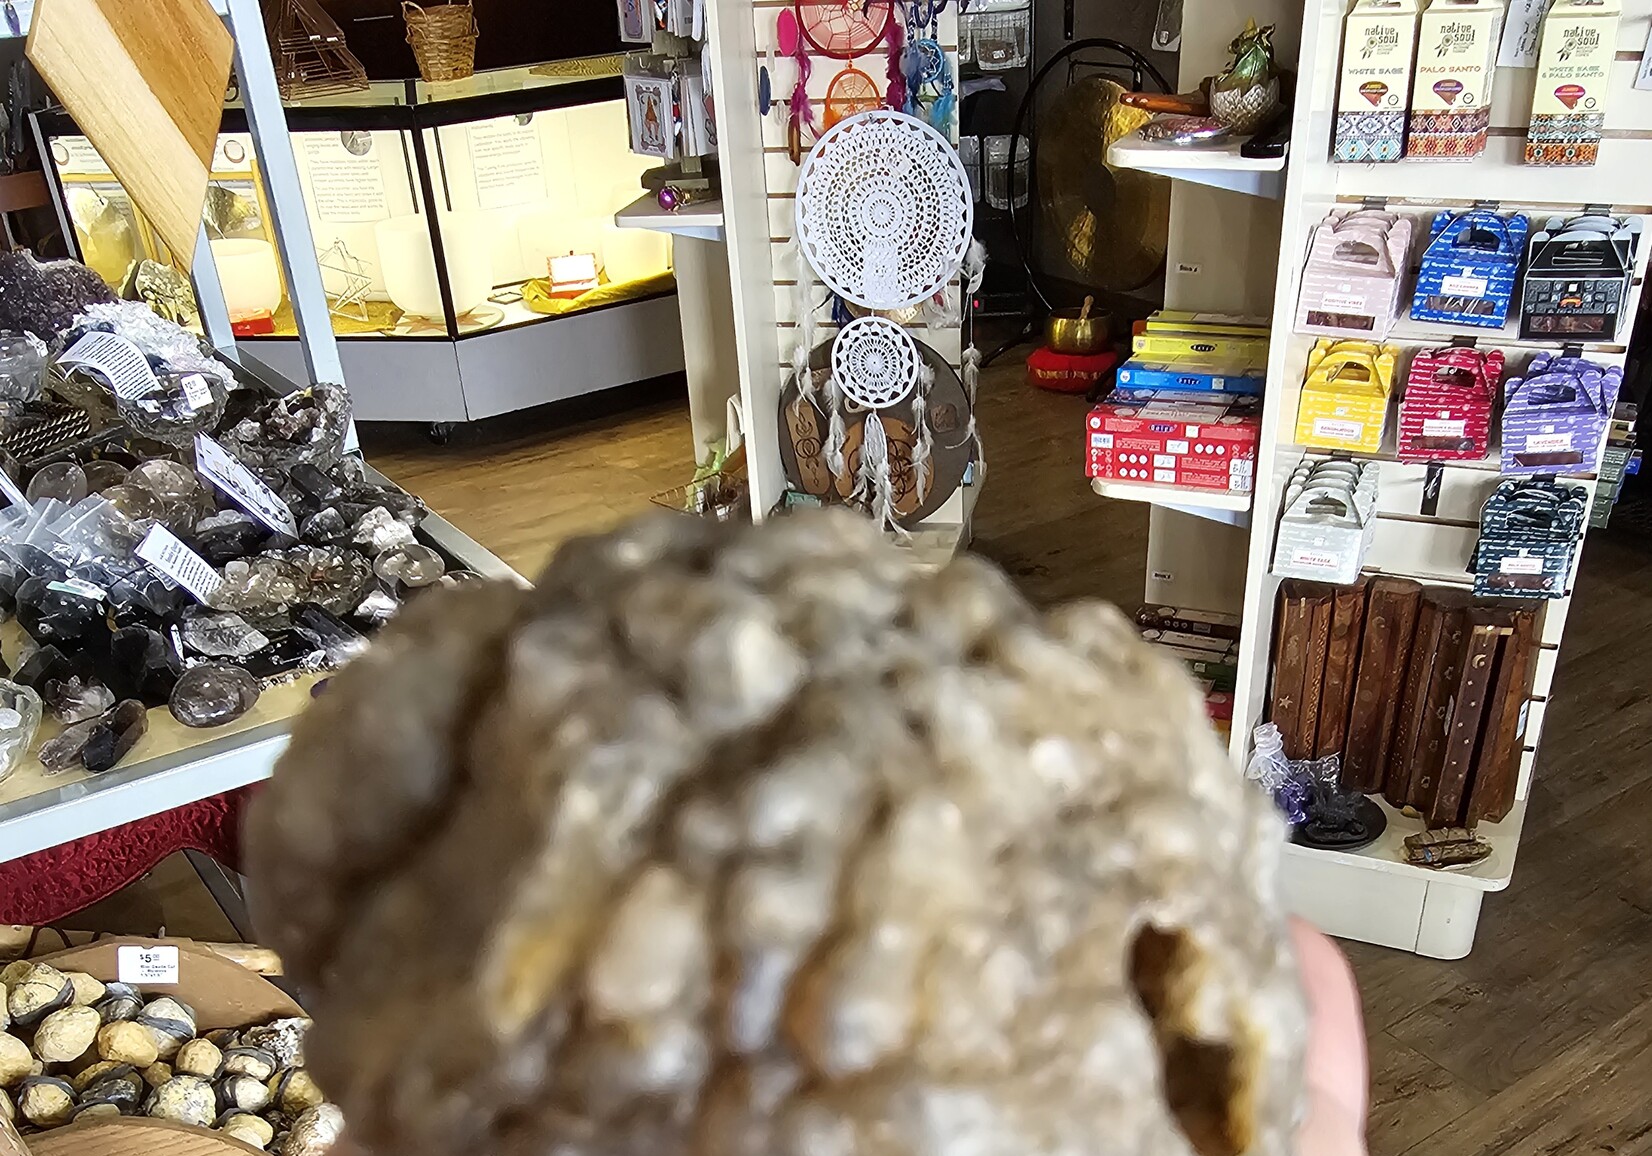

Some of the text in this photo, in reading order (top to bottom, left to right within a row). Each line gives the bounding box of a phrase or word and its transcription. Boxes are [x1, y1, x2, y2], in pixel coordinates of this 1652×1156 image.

[1365, 24, 1395, 36] native
[1440, 21, 1472, 34] native
[1563, 26, 1596, 38] native
[1378, 32, 1399, 44] soul
[1454, 29, 1476, 42] soul
[1577, 33, 1600, 46] soul
[1420, 65, 1482, 74] PALO SANTO
